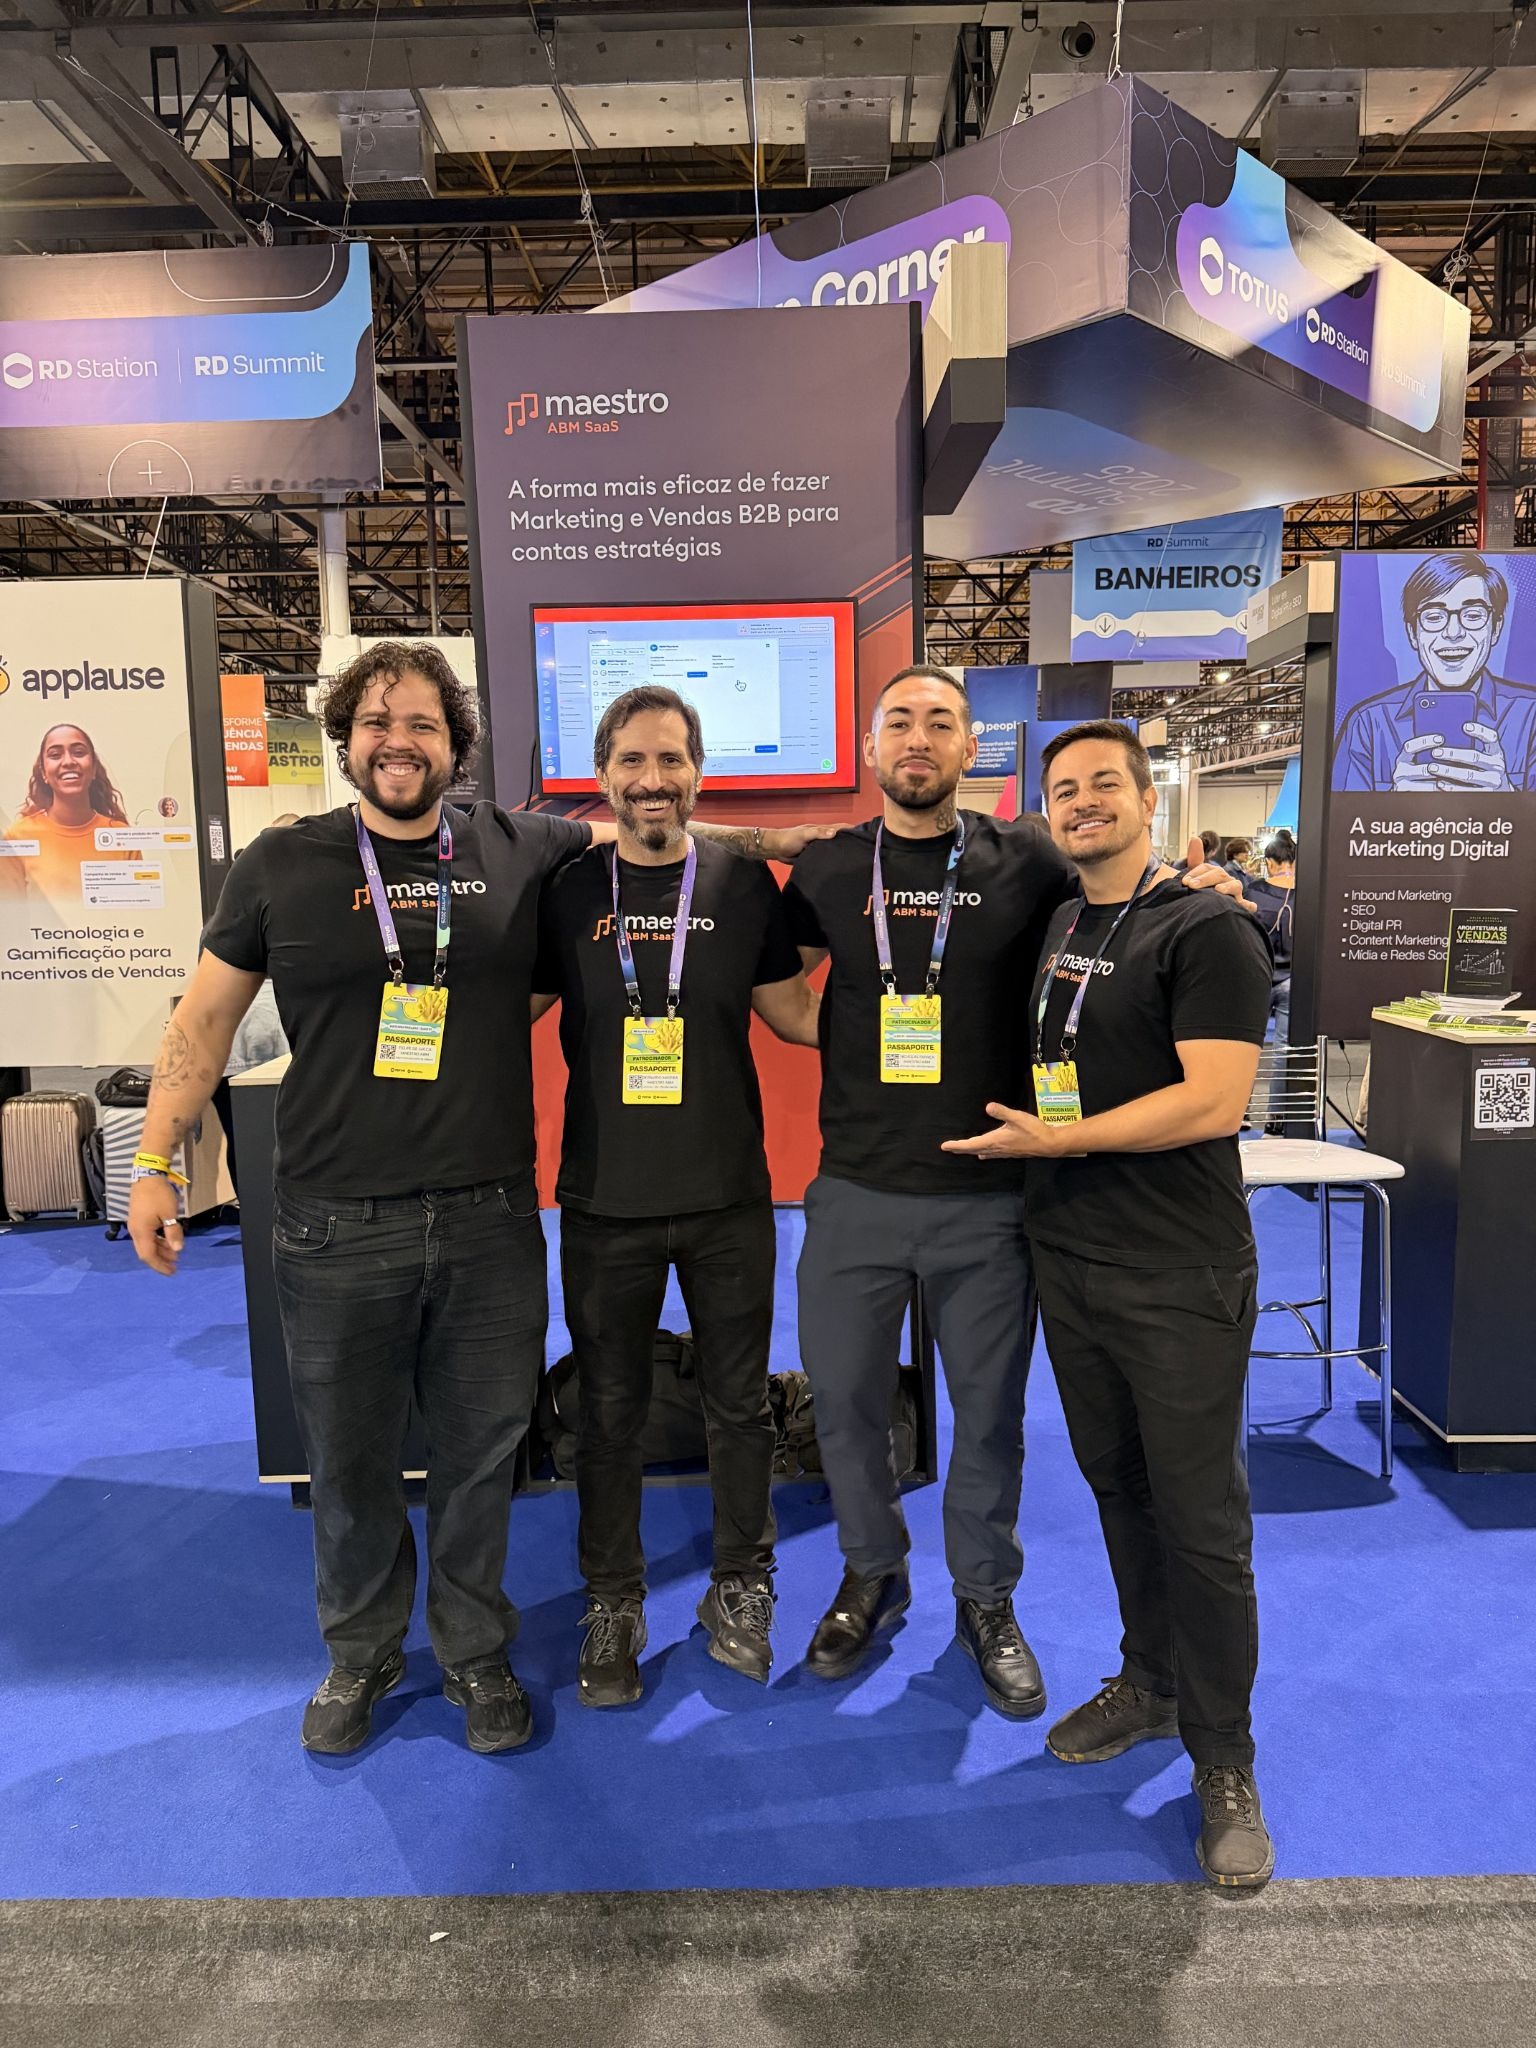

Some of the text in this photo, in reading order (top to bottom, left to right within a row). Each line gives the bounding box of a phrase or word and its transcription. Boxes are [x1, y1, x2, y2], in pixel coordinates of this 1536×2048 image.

[1321, 321, 1369, 366] RD Station
[38, 356, 158, 380] RD Station
[195, 351, 326, 376] RD Summit
[545, 388, 669, 416] maestro
[547, 420, 619, 433] ABM SaaS
[508, 470, 830, 499] A forma mais eficaz de fazer
[986, 458, 1145, 507] Summit
[1083, 465, 1197, 497] 2025
[1026, 498, 1099, 515] RD
[511, 503, 840, 533] Marketing e Vendas B2B para
[512, 536, 722, 562] contas estratégias
[1147, 535, 1209, 548] RD Summit
[1095, 564, 1261, 591] BANHEIROS
[22, 660, 165, 699] applause
[1349, 817, 1513, 838] A sua agência de
[1349, 840, 1509, 861] Marketing Digital
[390, 899, 418, 909] ABM
[1351, 890, 1452, 903] Inbound Marketing
[893, 908, 917, 917] ABM
[1350, 905, 1376, 916] SEO
[31, 926, 144, 941] Tecnologia e
[1350, 919, 1402, 932] Digital PR
[1349, 934, 1449, 947] Content Marketing
[1457, 930, 1507, 941] VENDAS
[7, 945, 171, 962] Gamificação para
[1348, 949, 1378, 961] Mídia
[1380, 952, 1388, 961] e
[1390, 949, 1425, 961] Redes
[91, 966, 114, 980] de
[118, 965, 186, 978] Vendas
[385, 1035, 436, 1045] PASSAPORTE
